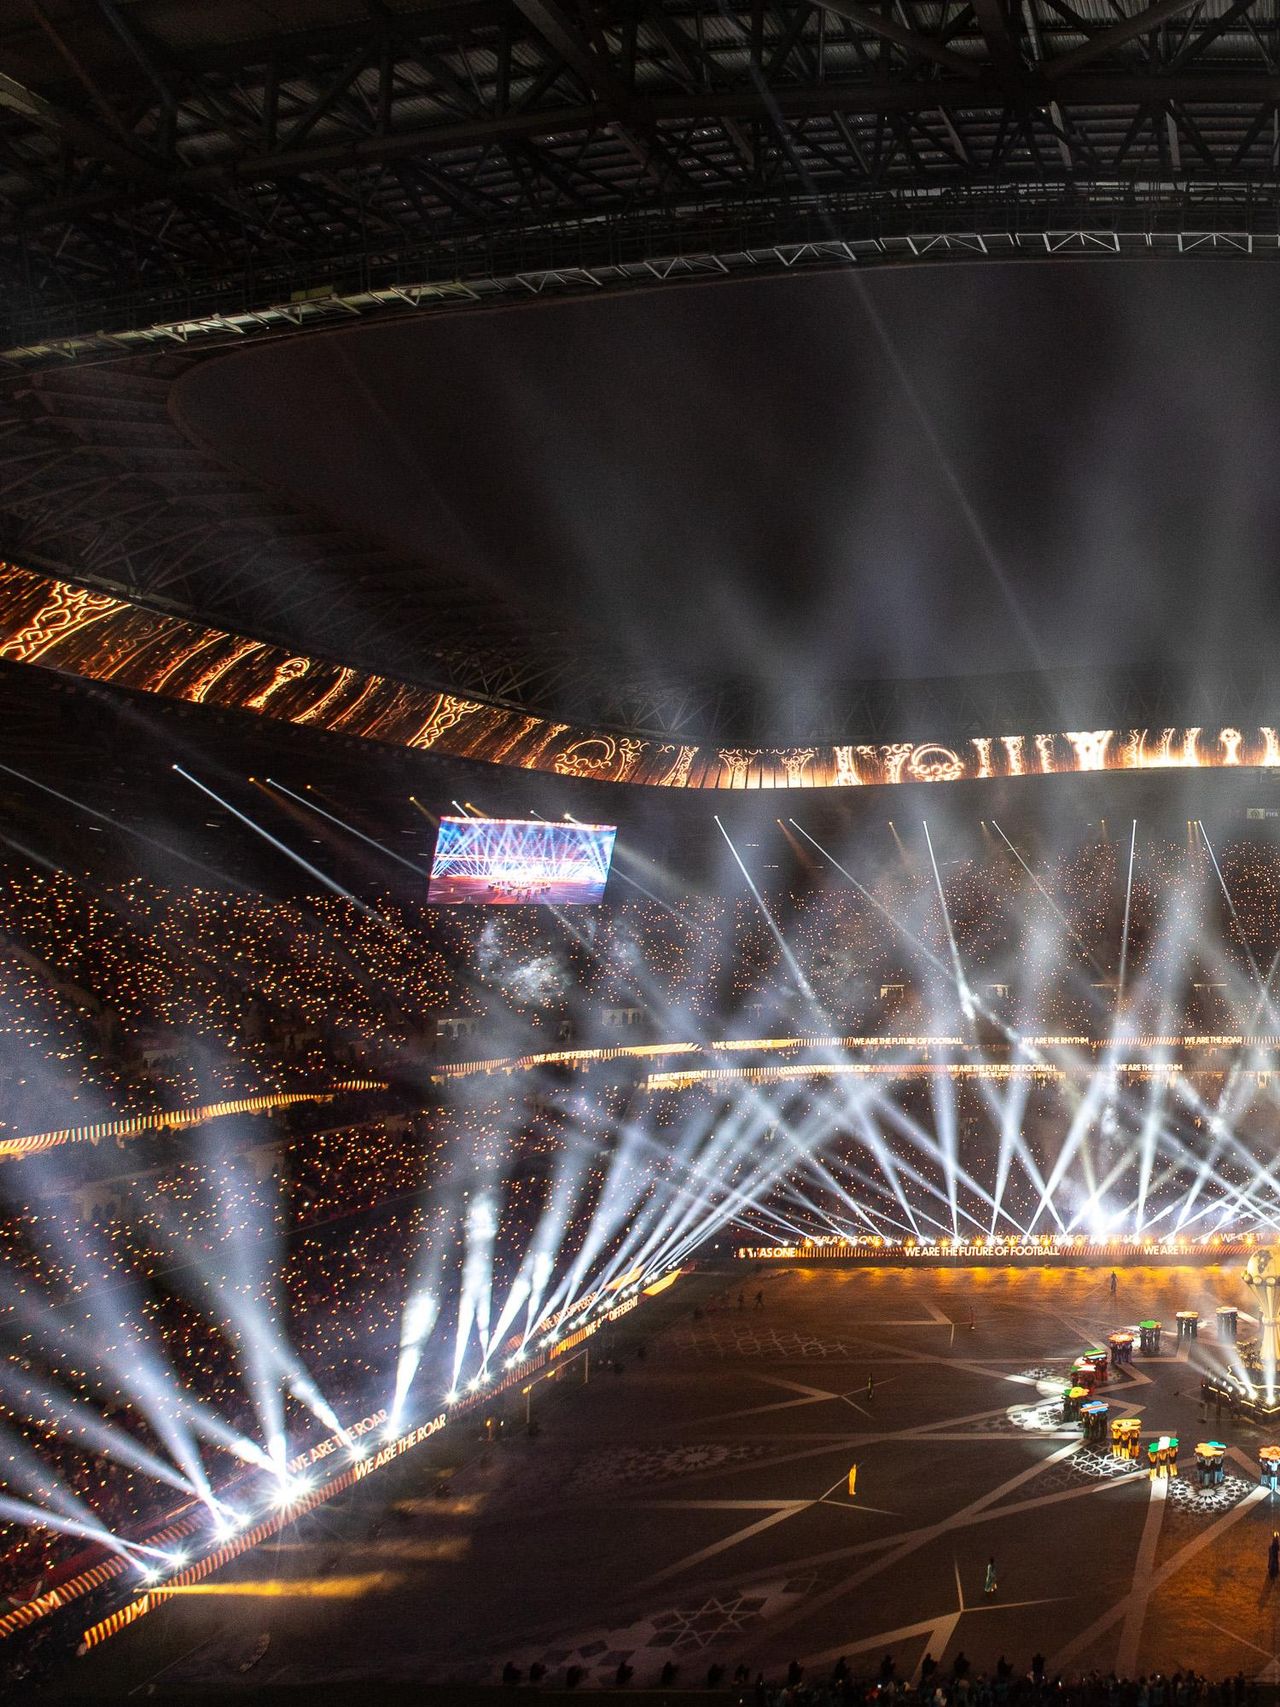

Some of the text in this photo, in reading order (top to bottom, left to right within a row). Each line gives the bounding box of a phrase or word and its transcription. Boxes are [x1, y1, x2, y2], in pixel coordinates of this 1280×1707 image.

[853, 1037, 865, 1045] WE
[865, 1037, 879, 1045] ARE
[928, 1037, 963, 1045] FOOTBALL
[1184, 1036, 1242, 1044] WE ARE THE ROAR
[533, 1050, 600, 1063] WE ARE DIFFERENT
[947, 1064, 1056, 1072] WE ARE THE FUTURE OF FOOTBALL
[1154, 1063, 1183, 1071] RHYTHM
[669, 1070, 707, 1080] DIFFERENT
[773, 1247, 796, 1258] ONE
[905, 1246, 1060, 1256] WE ARE THE FUTURE OF FOOTBALL
[1144, 1245, 1159, 1255] WE
[1159, 1245, 1179, 1255] ARE
[609, 1294, 639, 1322] DIFFERENT
[287, 1408, 389, 1474] WE ARE TE ROAR
[354, 1413, 447, 1481] WE ARE THE ROAR
